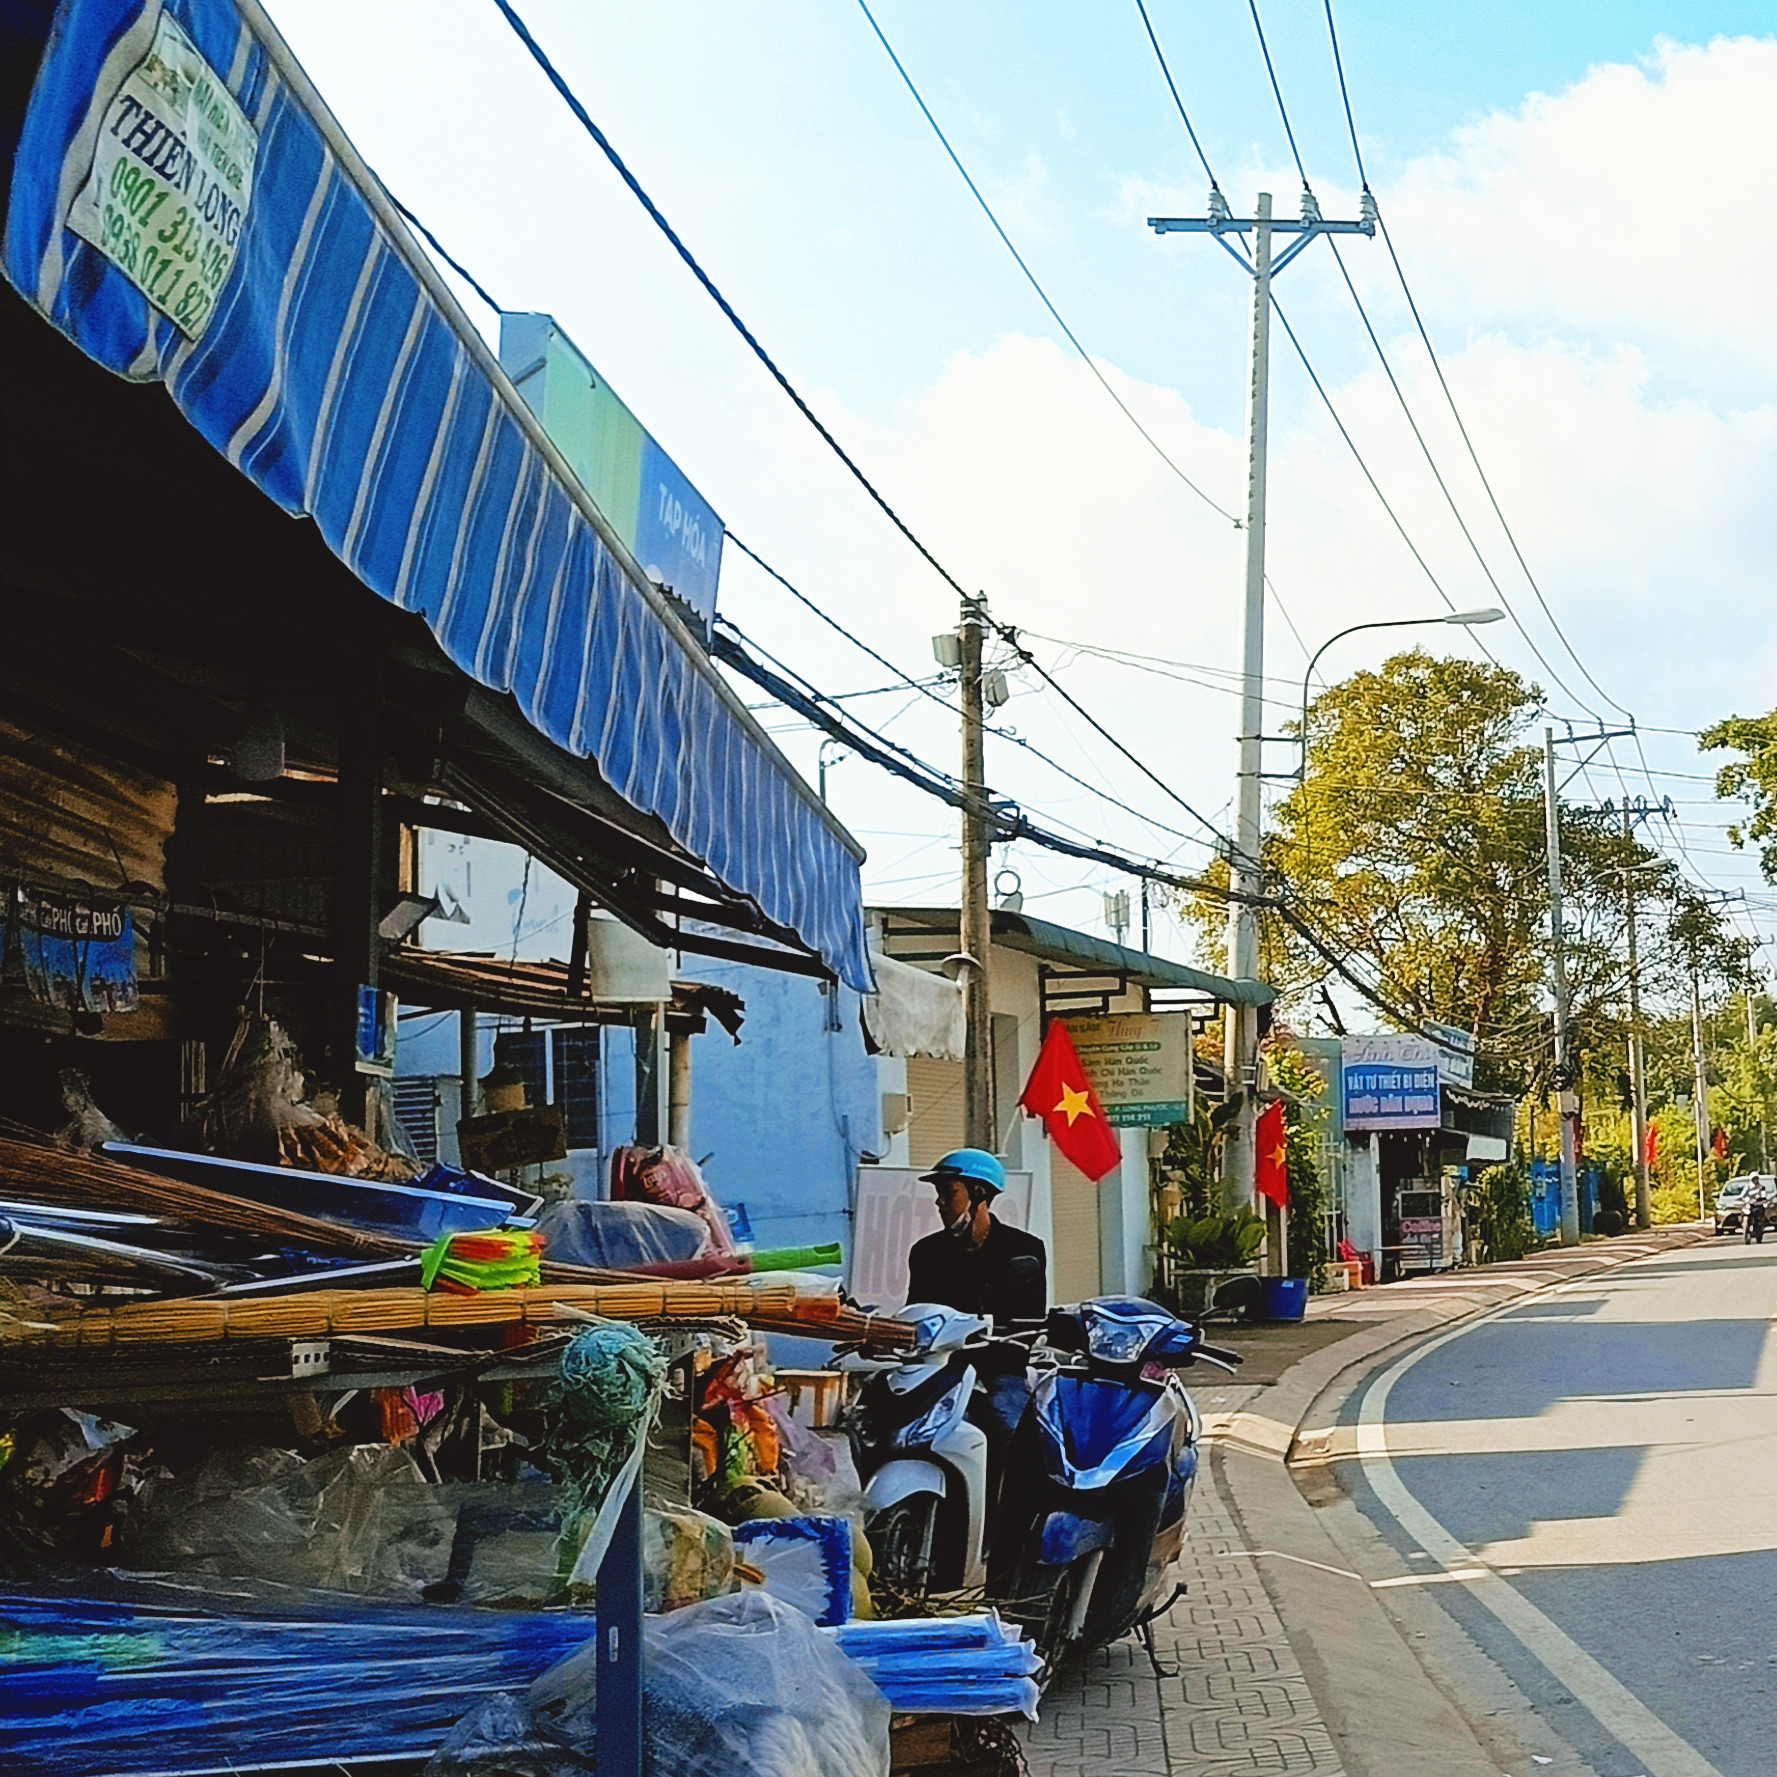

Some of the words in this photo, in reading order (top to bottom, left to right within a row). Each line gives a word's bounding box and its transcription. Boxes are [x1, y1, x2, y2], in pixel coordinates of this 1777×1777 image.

[110, 95, 197, 195] THIÊN
[195, 169, 241, 249] LONG
[111, 157, 169, 228] 0901
[158, 206, 201, 263] 313
[140, 245, 184, 305] 011
[175, 281, 211, 331] 827
[658, 483, 680, 539] TẠP
[681, 514, 706, 569] HÓA
[92, 905, 121, 936] PHỐ
